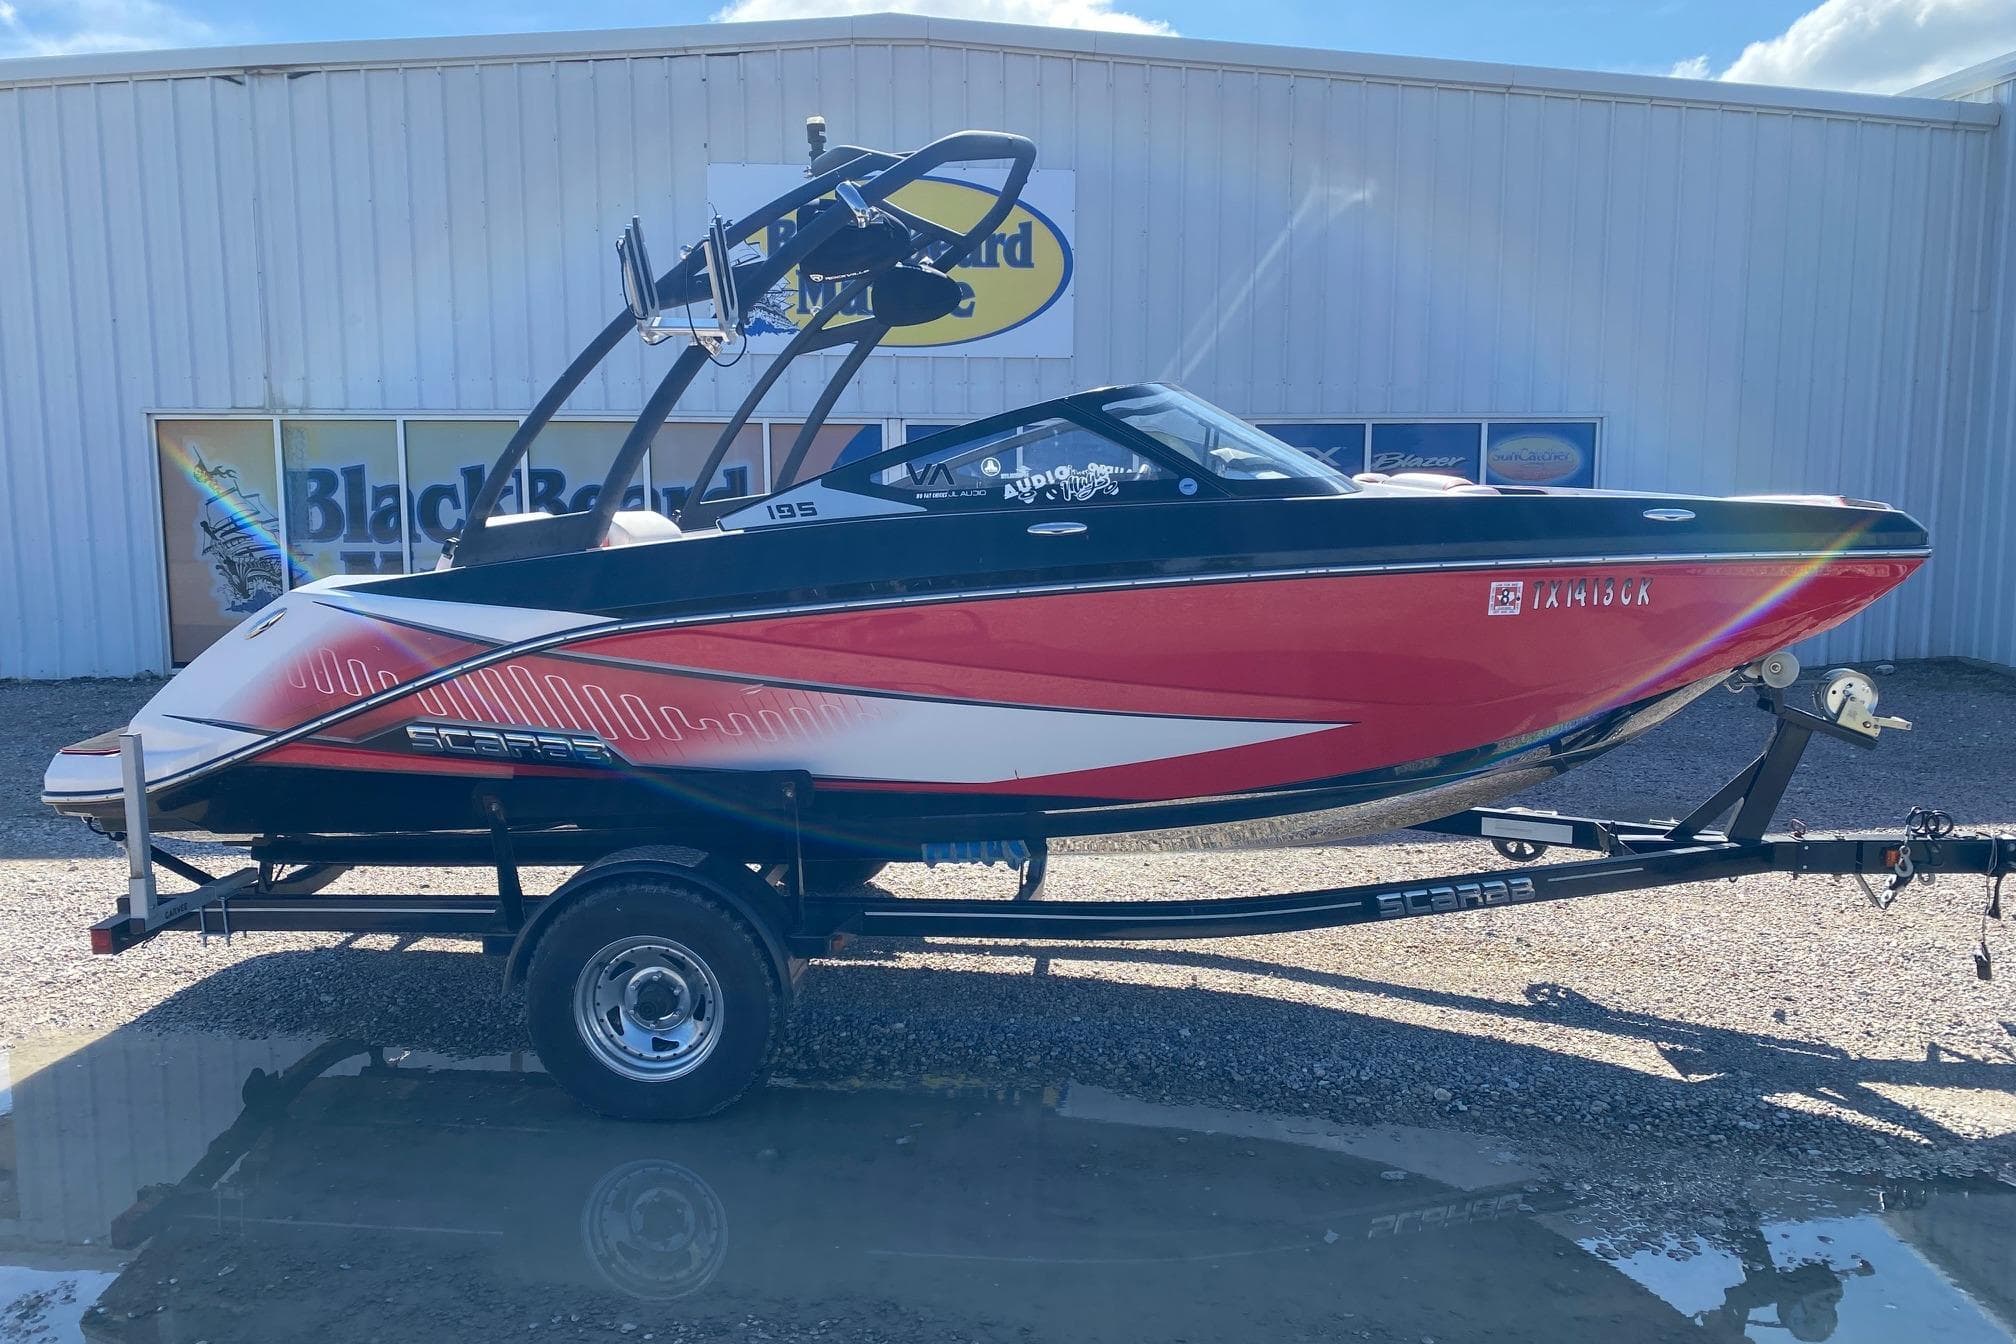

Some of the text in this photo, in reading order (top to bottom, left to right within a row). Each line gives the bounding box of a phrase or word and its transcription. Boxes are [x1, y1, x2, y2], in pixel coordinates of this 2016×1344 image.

[1372, 452, 1466, 471] Blazer
[1004, 465, 1072, 500] AUDIO
[948, 489, 987, 498] JL AUDIO
[766, 501, 818, 521] 195
[1500, 588, 1510, 606] 8
[406, 725, 613, 765] SCARAB
[1376, 877, 1536, 918] SCARAB
